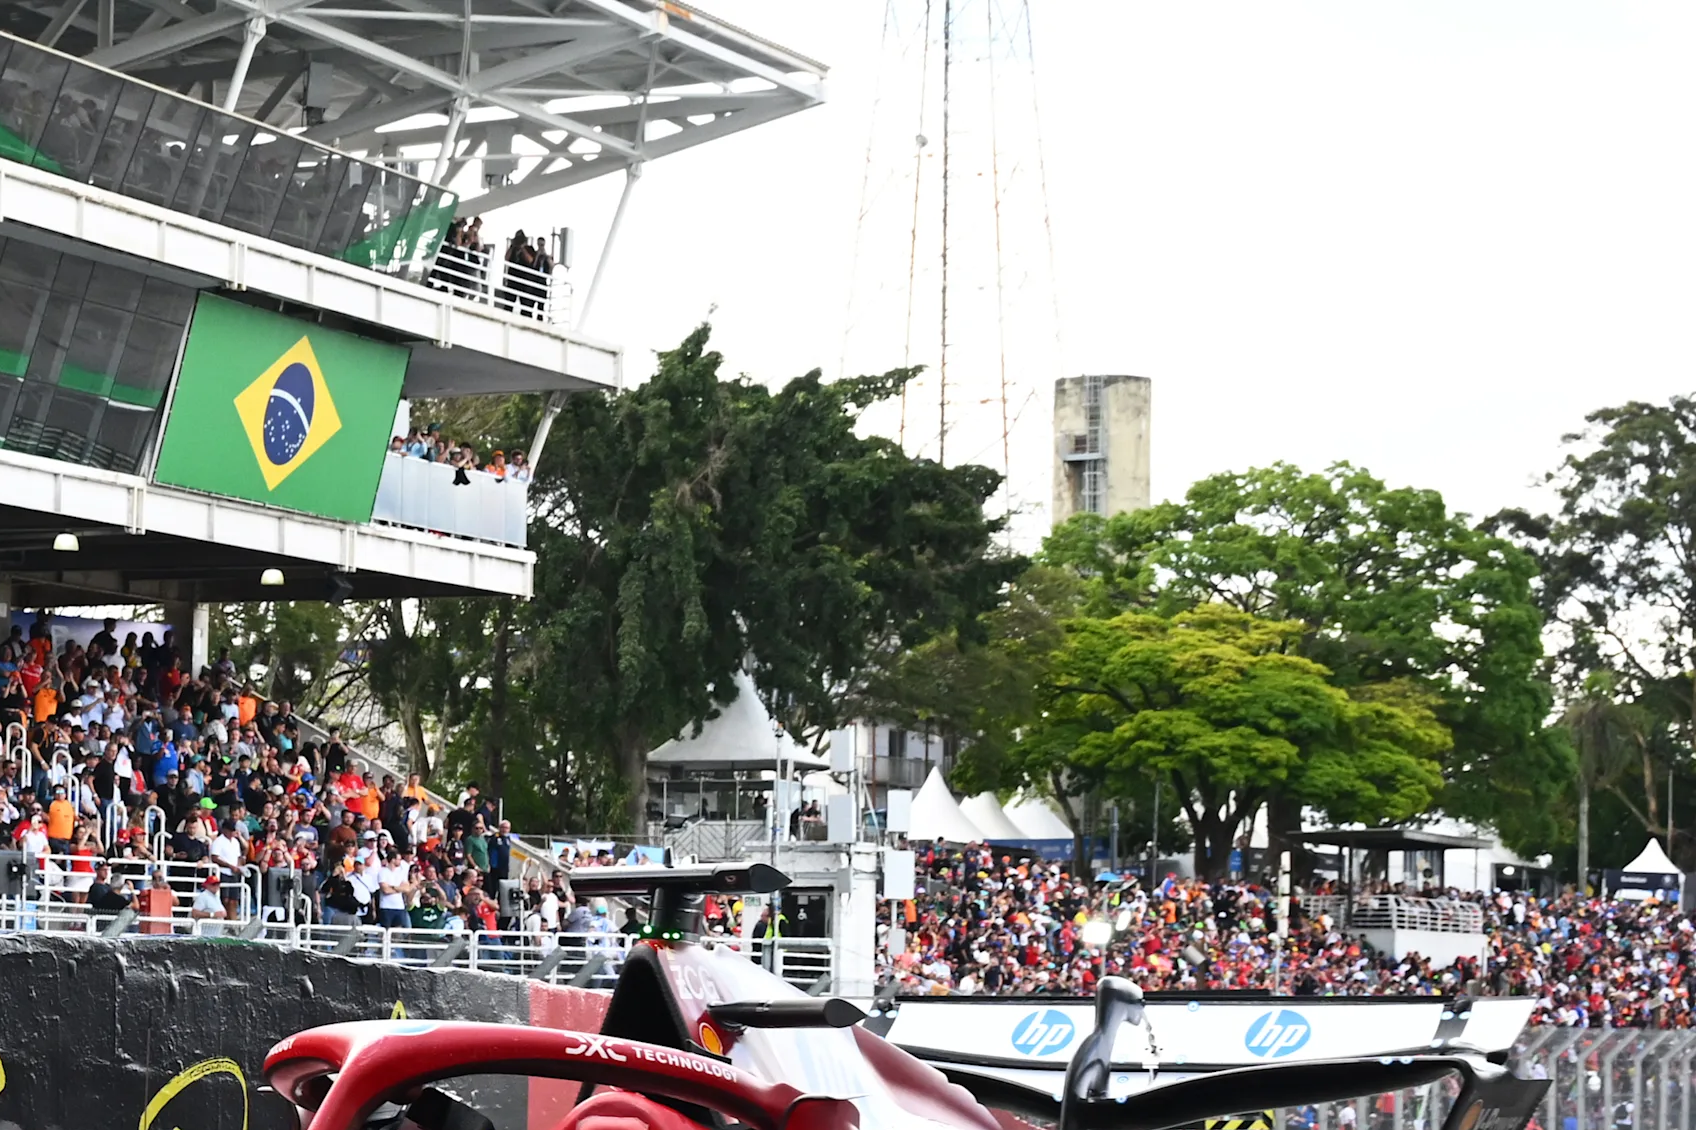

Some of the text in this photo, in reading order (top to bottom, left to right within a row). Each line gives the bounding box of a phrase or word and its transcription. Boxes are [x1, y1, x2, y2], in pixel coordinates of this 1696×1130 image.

[669, 963, 719, 1001] ZCG
[1016, 1009, 1070, 1056] hp
[1250, 1009, 1307, 1058] hp
[565, 1033, 739, 1083] DXC TECHNOLOGY
